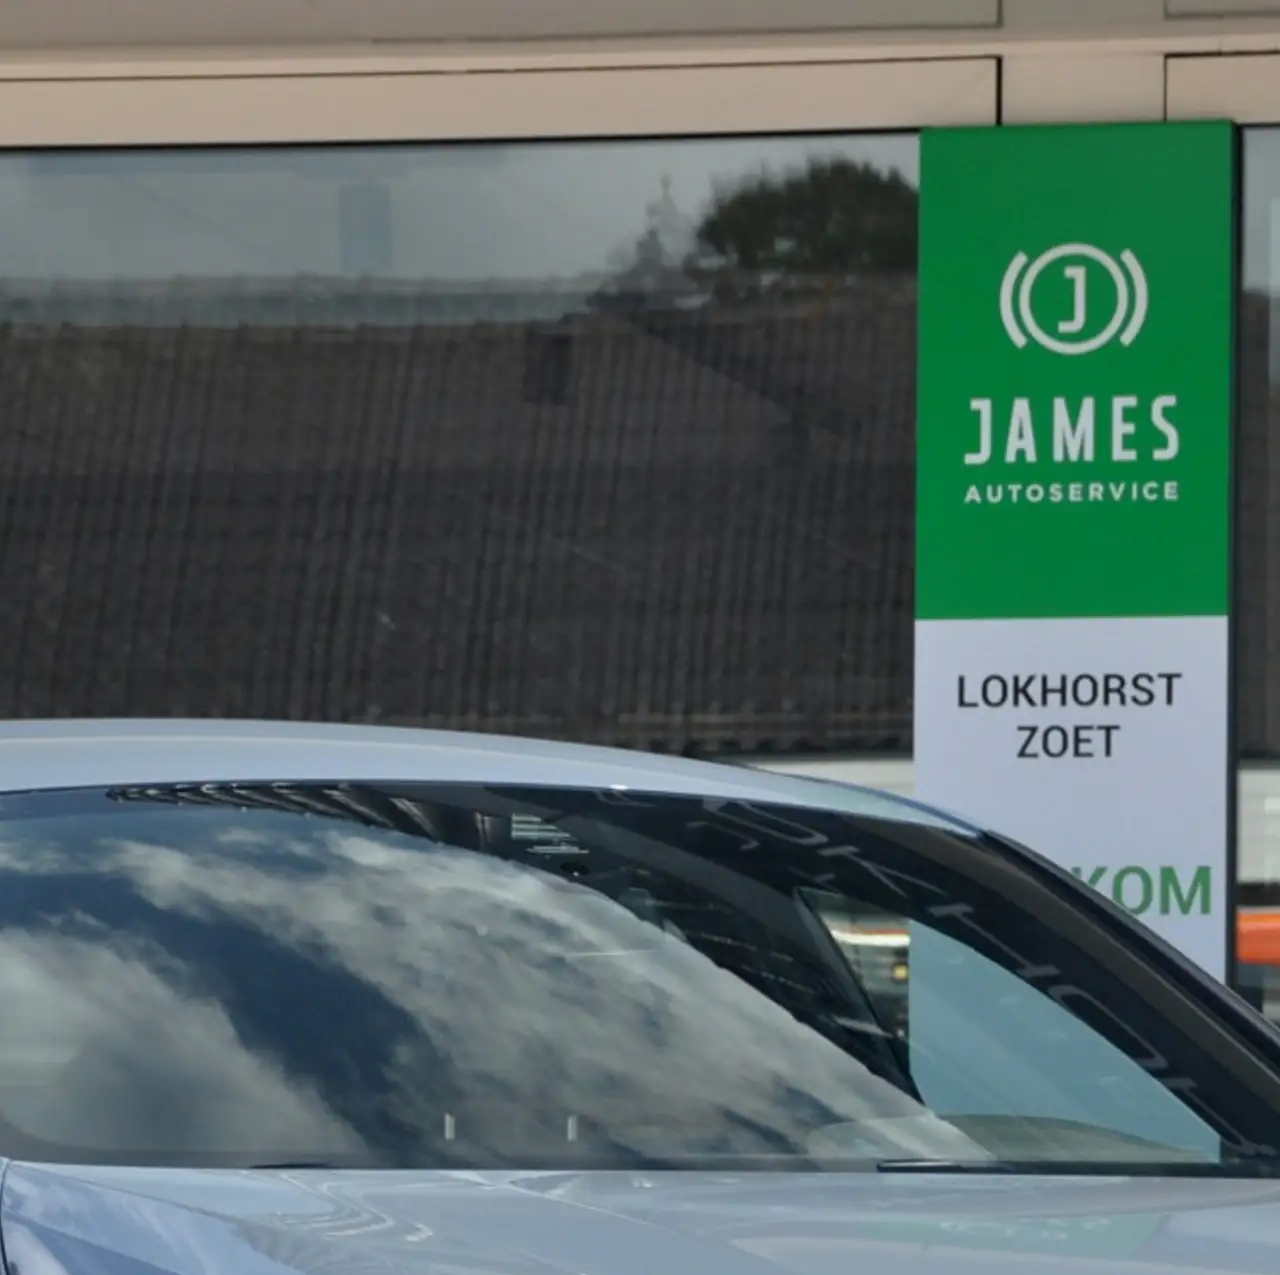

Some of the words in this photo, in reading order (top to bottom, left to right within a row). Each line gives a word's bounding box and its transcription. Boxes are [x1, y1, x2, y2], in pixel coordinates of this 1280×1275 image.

[963, 394, 1180, 465] JAMES
[964, 480, 1180, 504] AUTOSERVICE
[957, 672, 1183, 708] LOKHORST
[1016, 724, 1121, 759] ZOET
